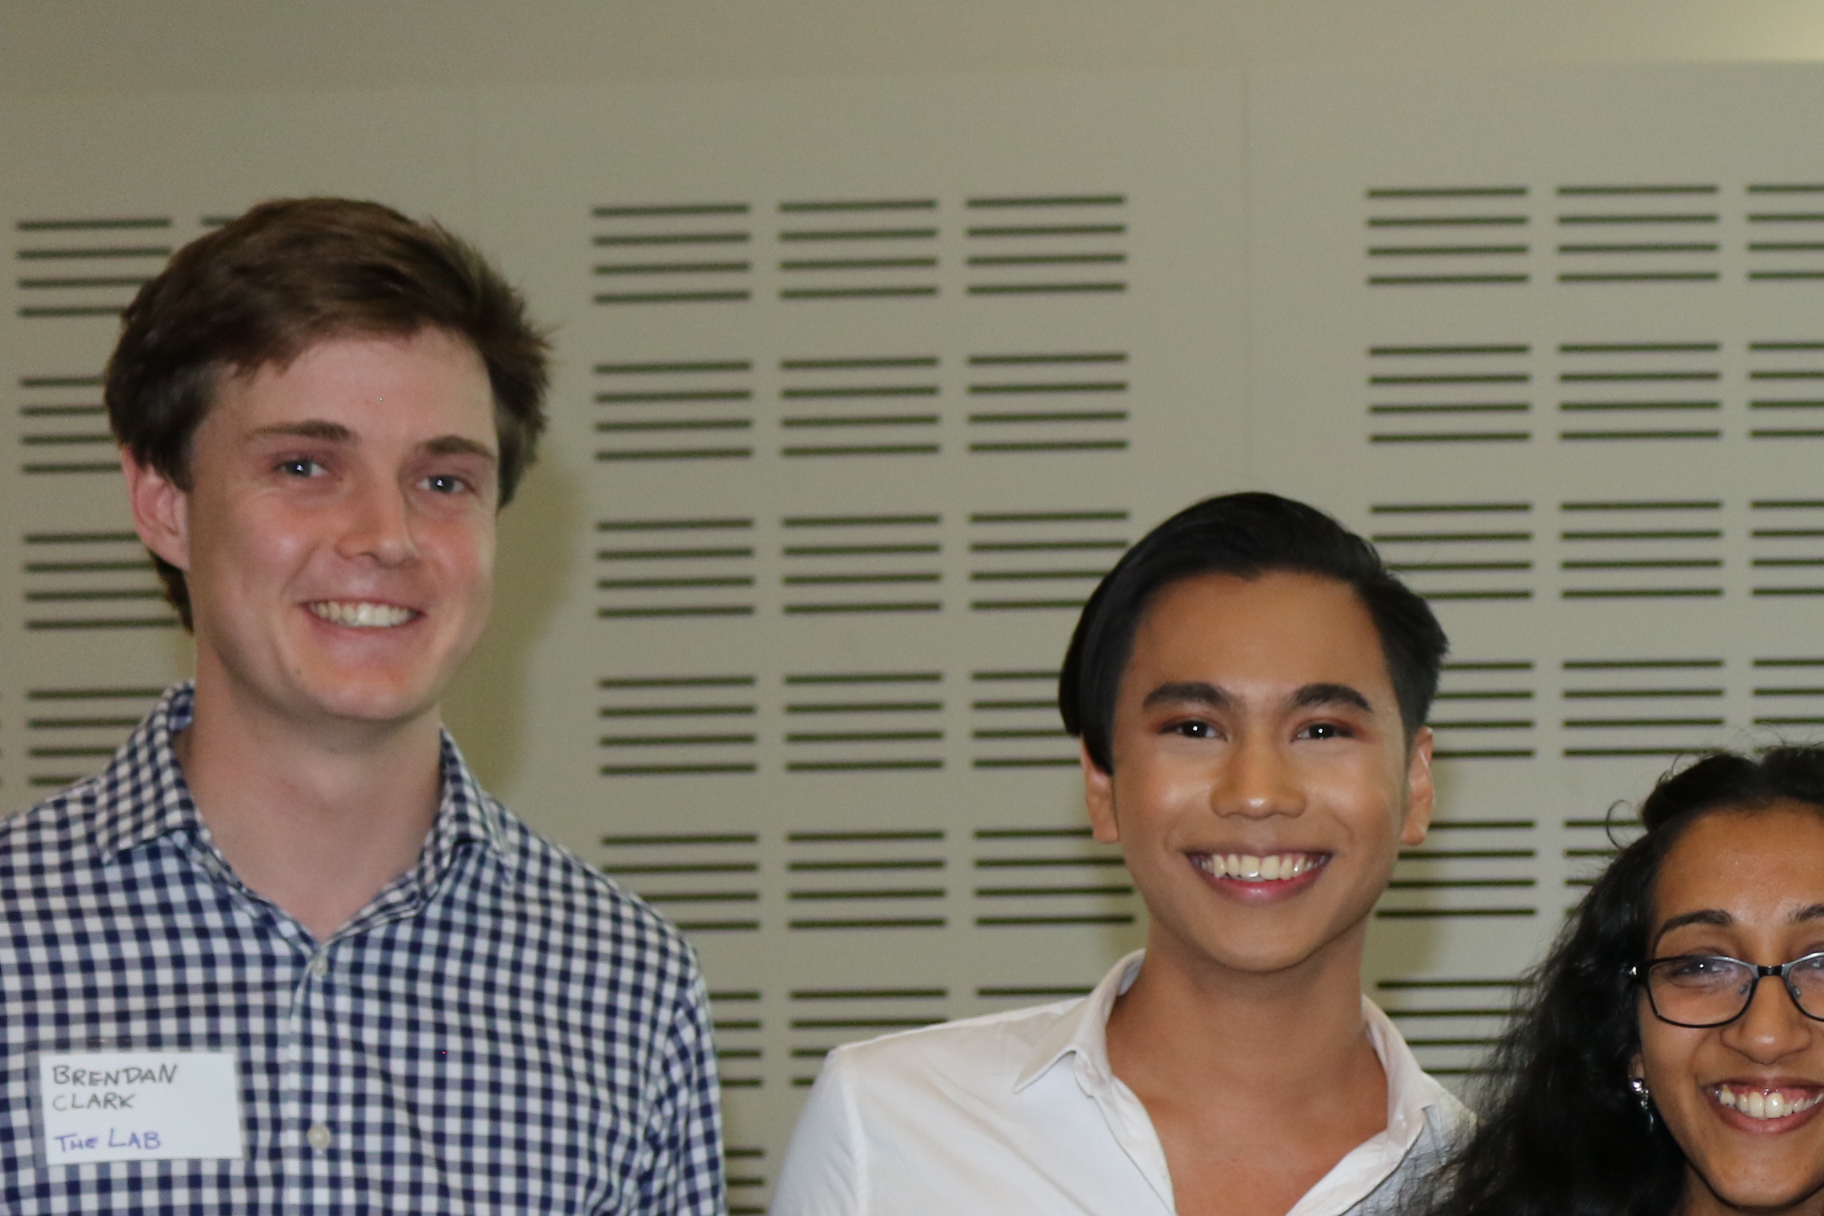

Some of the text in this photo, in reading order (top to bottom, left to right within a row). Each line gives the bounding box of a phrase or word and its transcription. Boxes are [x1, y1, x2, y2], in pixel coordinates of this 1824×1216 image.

[52, 1063, 178, 1085] BRENDAN
[52, 1092, 136, 1112] CLARK
[108, 1128, 162, 1150] LAB
